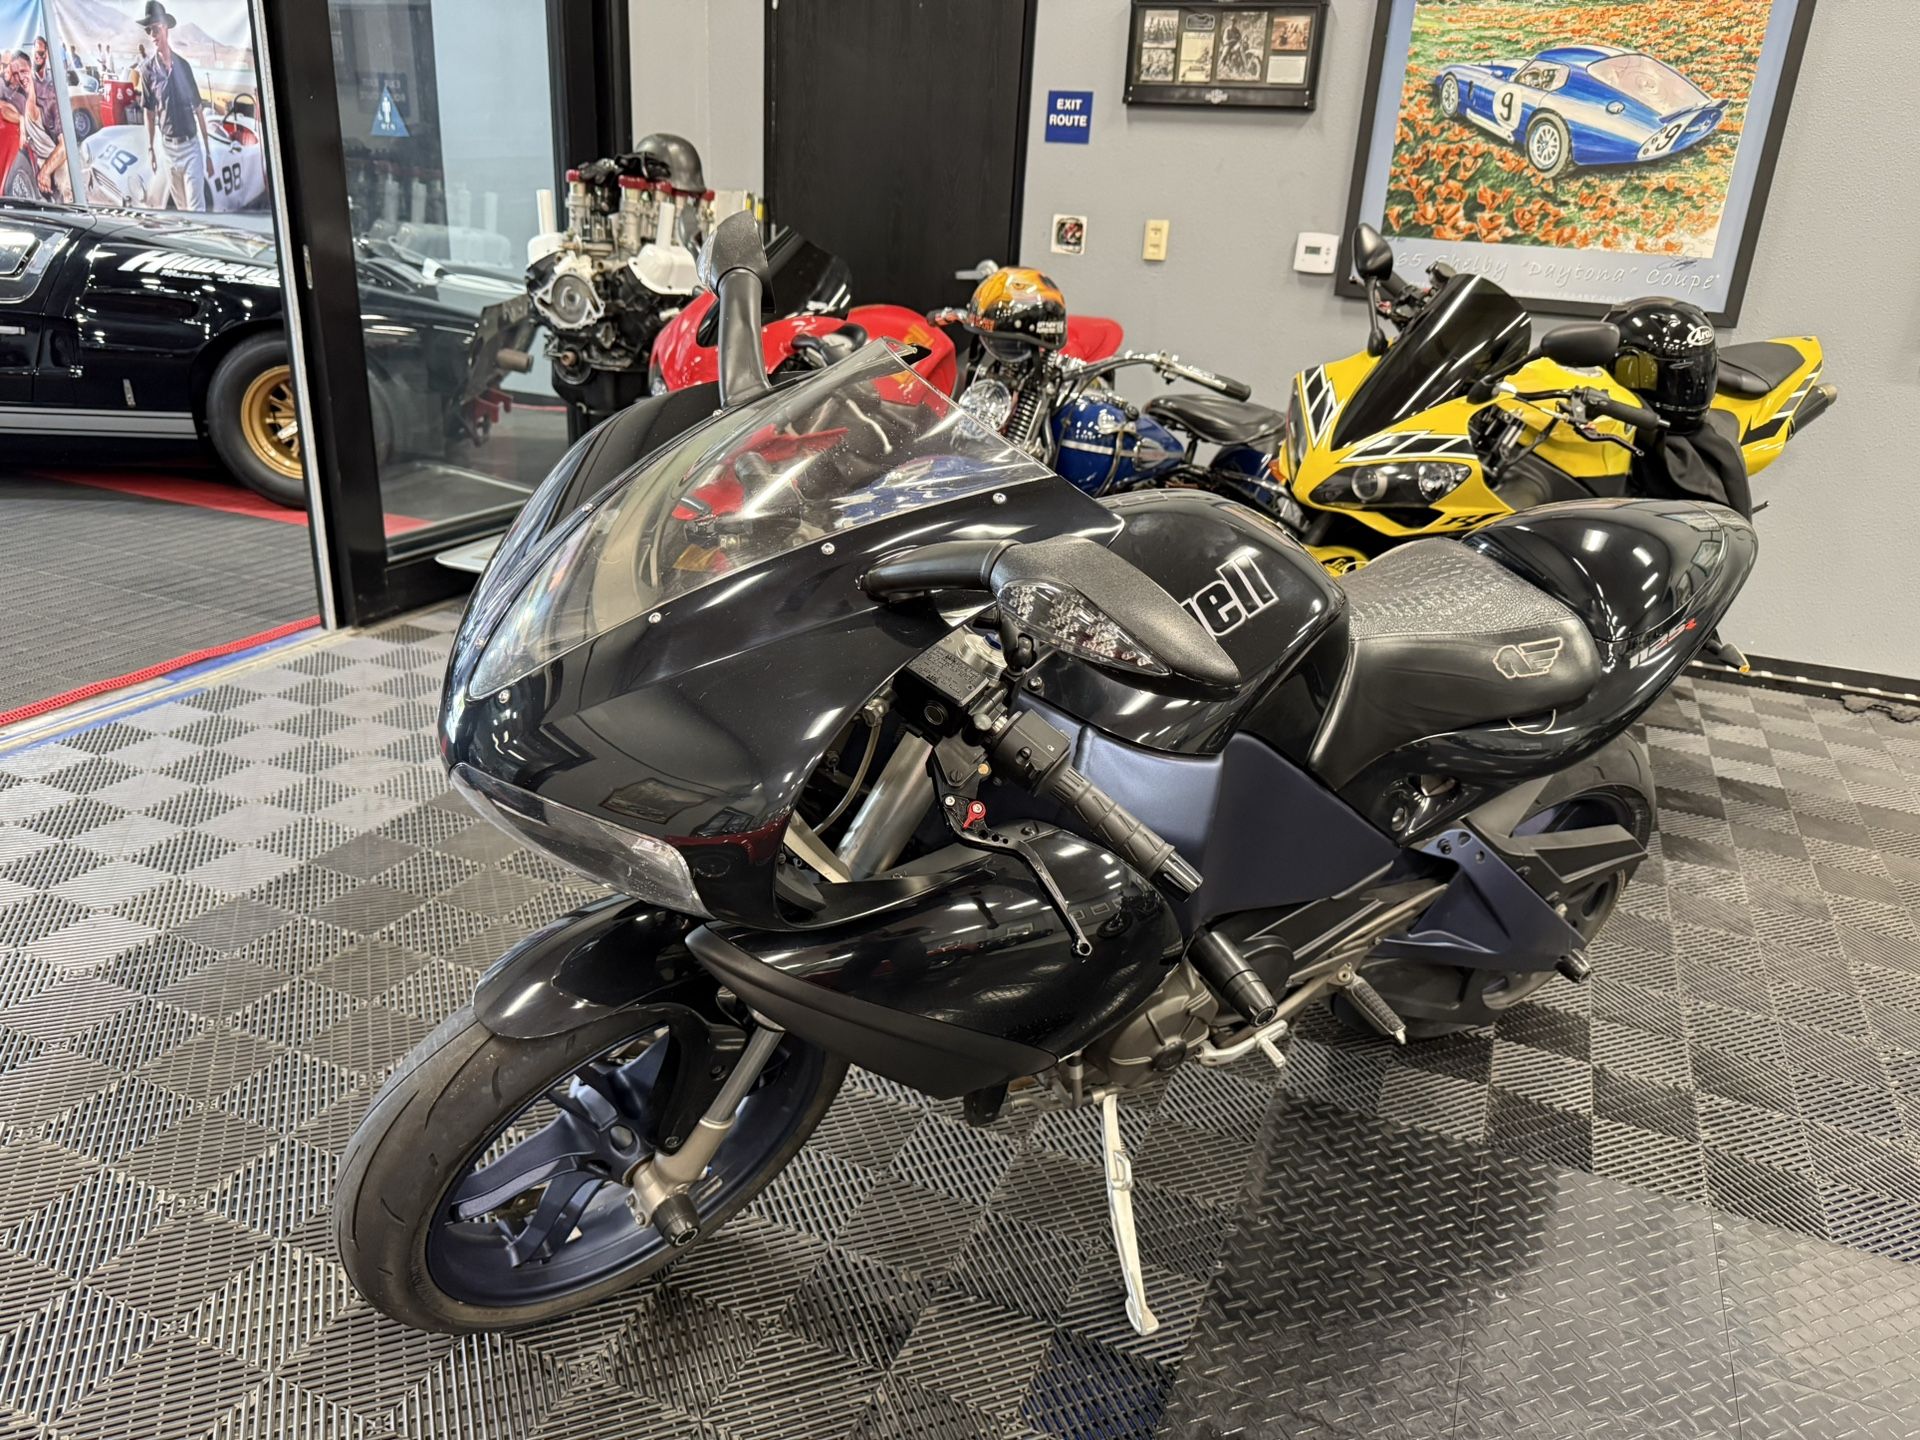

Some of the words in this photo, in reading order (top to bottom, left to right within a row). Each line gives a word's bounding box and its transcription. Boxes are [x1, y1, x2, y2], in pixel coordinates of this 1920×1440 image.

[1056, 98, 1083, 110] EXIT
[1500, 92, 1515, 121] 9
[1049, 113, 1088, 127] ROUTE
[1656, 124, 1682, 151] 9
[222, 162, 242, 197] 98
